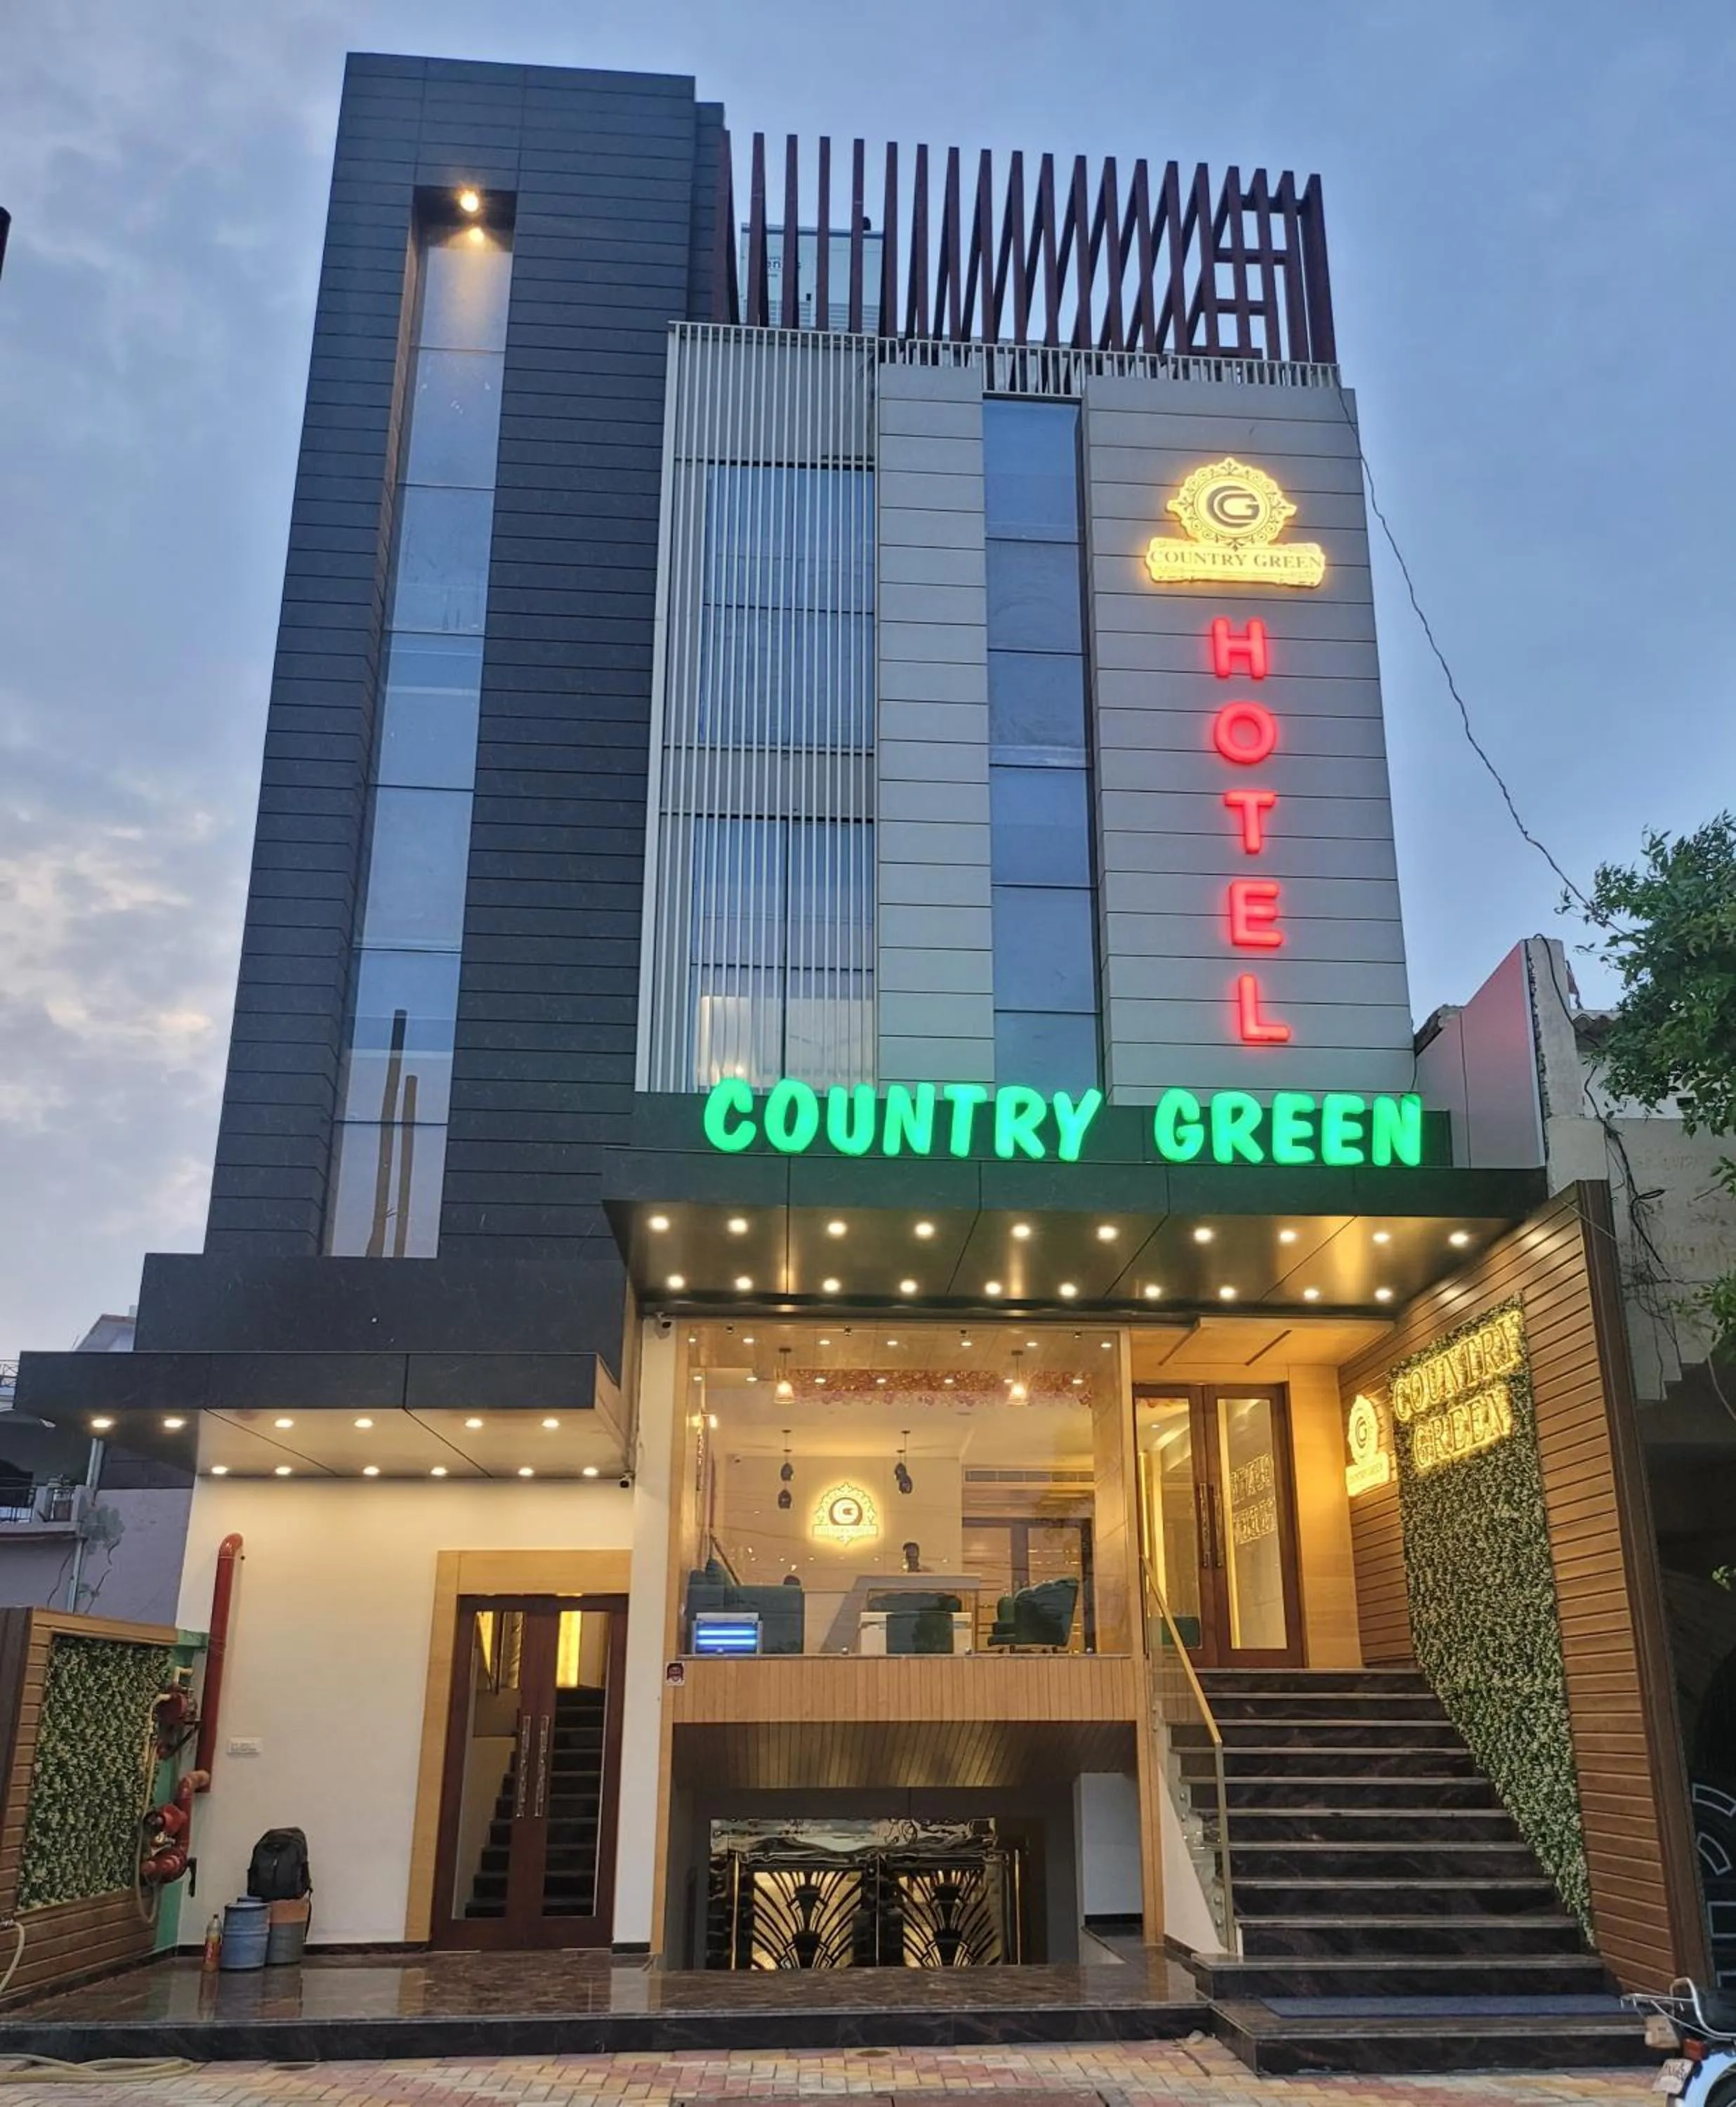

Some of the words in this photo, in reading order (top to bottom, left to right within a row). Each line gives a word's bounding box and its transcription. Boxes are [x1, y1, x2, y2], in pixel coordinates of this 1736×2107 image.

[1150, 550, 1246, 567] COUNTRY
[1254, 553, 1323, 570] GREEN
[1211, 617, 1291, 1042] HOTEL
[703, 1077, 1102, 1162] COUNTRY
[1154, 1087, 1422, 1167] GREEN
[1393, 1311, 1523, 1421] COUNTRY
[1412, 1384, 1511, 1469] GREEN
